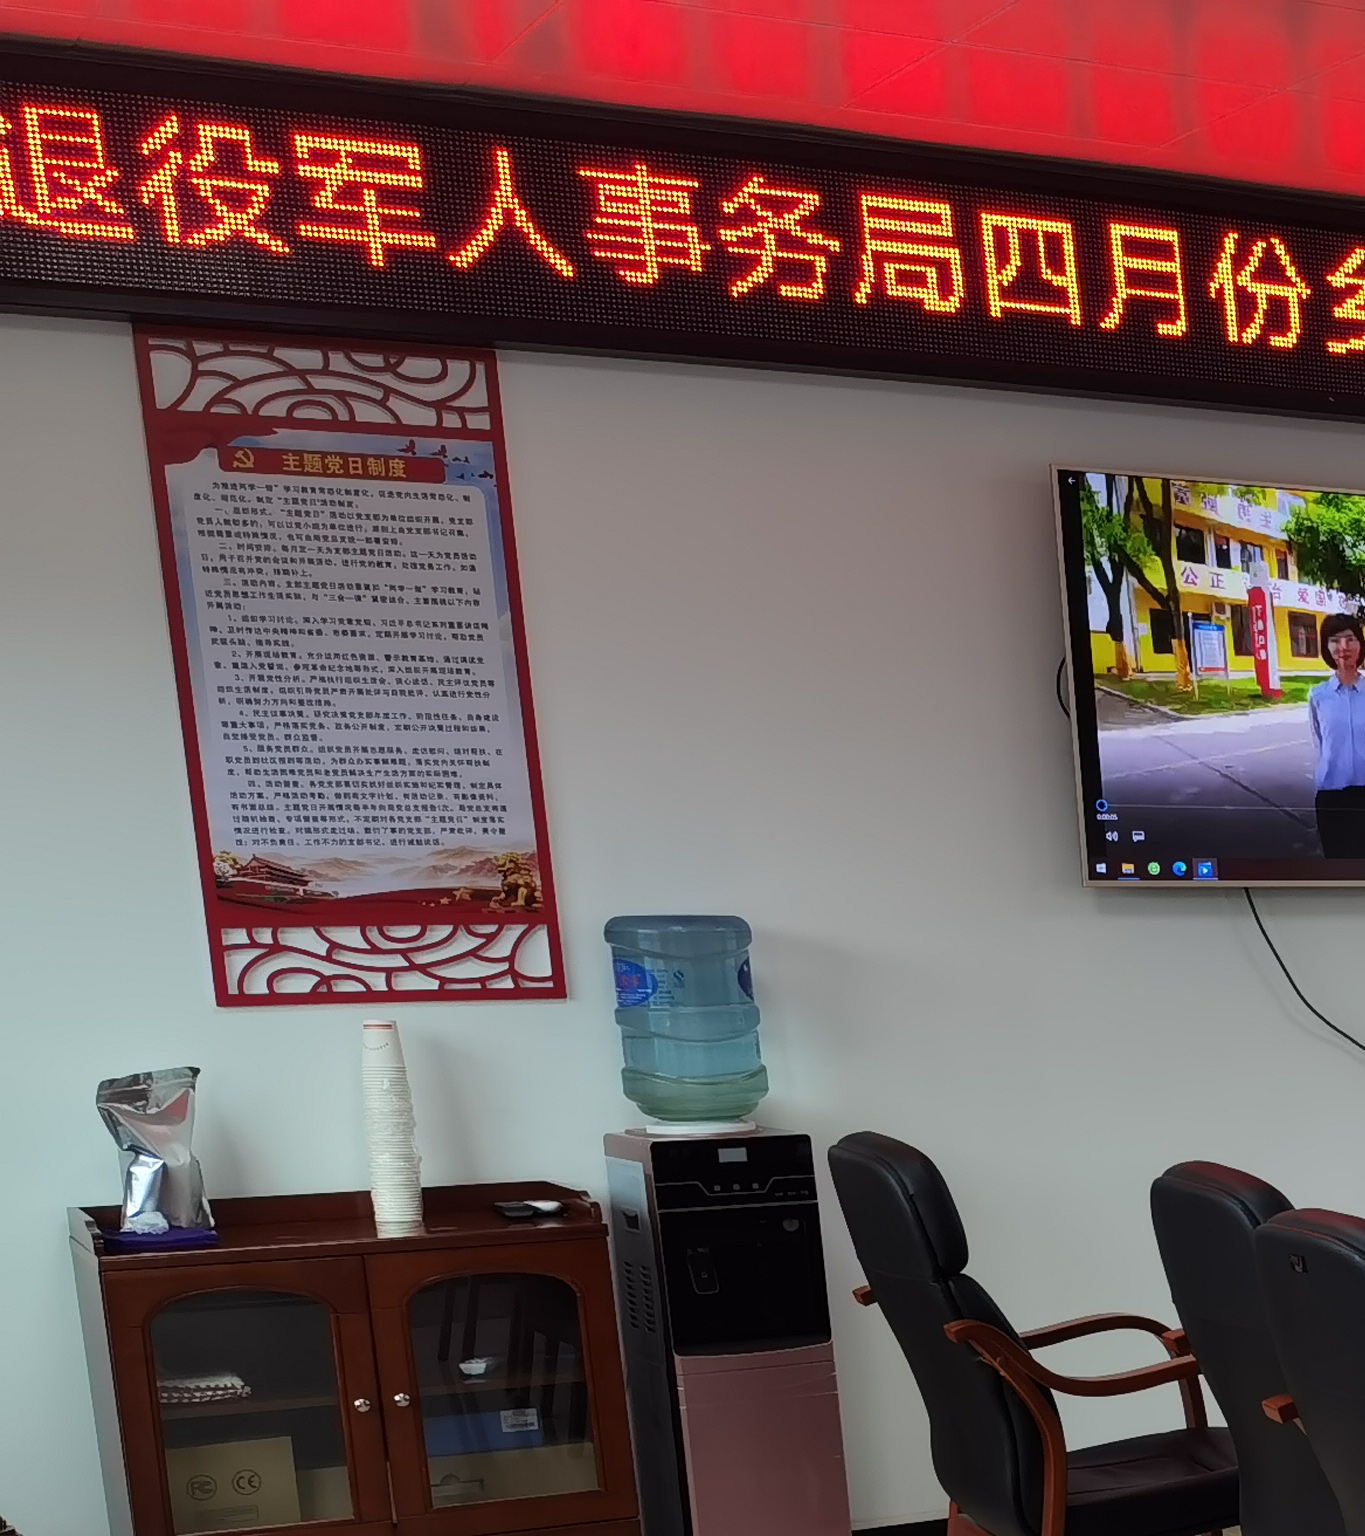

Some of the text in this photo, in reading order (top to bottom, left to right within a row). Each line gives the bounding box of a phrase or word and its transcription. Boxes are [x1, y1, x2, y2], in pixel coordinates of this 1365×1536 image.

[282, 453, 407, 478] 主题党日制度
